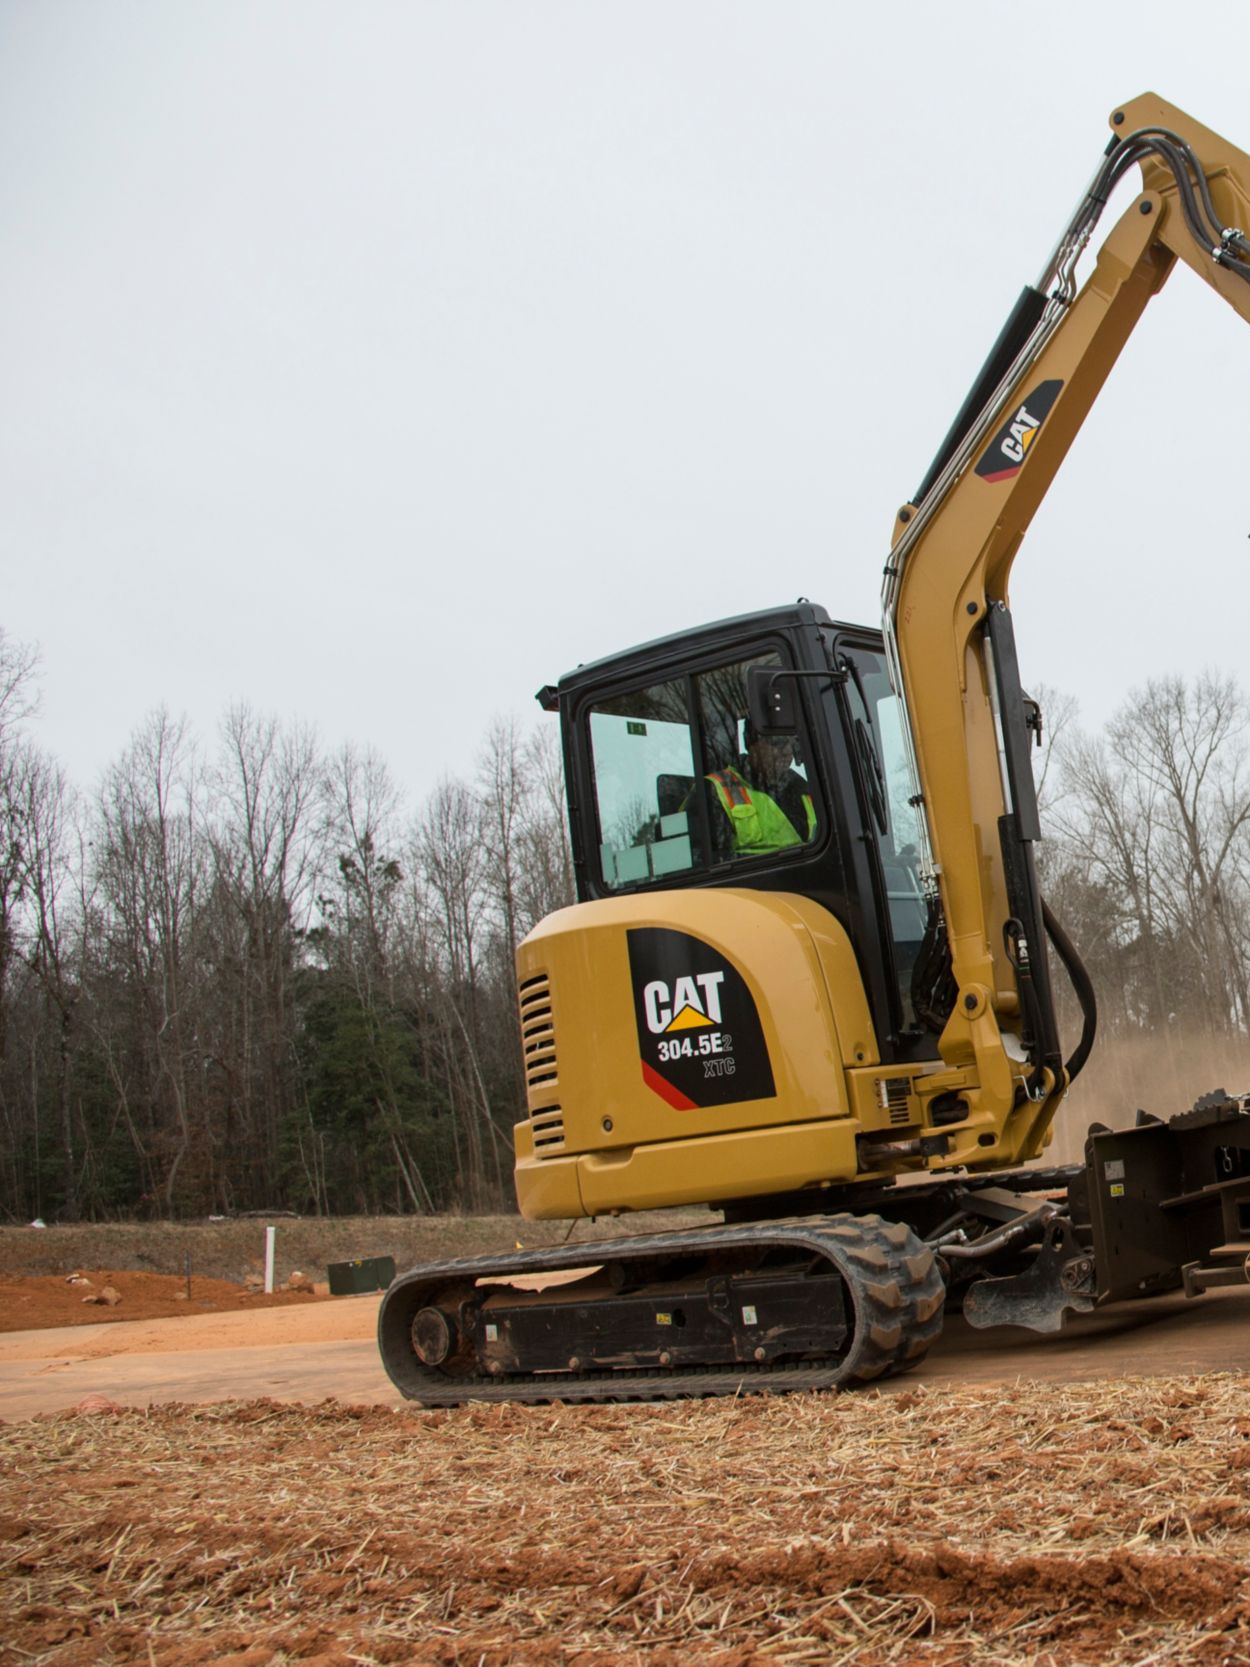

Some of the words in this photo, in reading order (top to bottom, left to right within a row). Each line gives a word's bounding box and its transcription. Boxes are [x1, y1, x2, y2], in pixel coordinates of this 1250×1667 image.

[1001, 405, 1040, 462] CAT
[644, 971, 724, 1034] CAT
[703, 1057, 736, 1078] XTC
